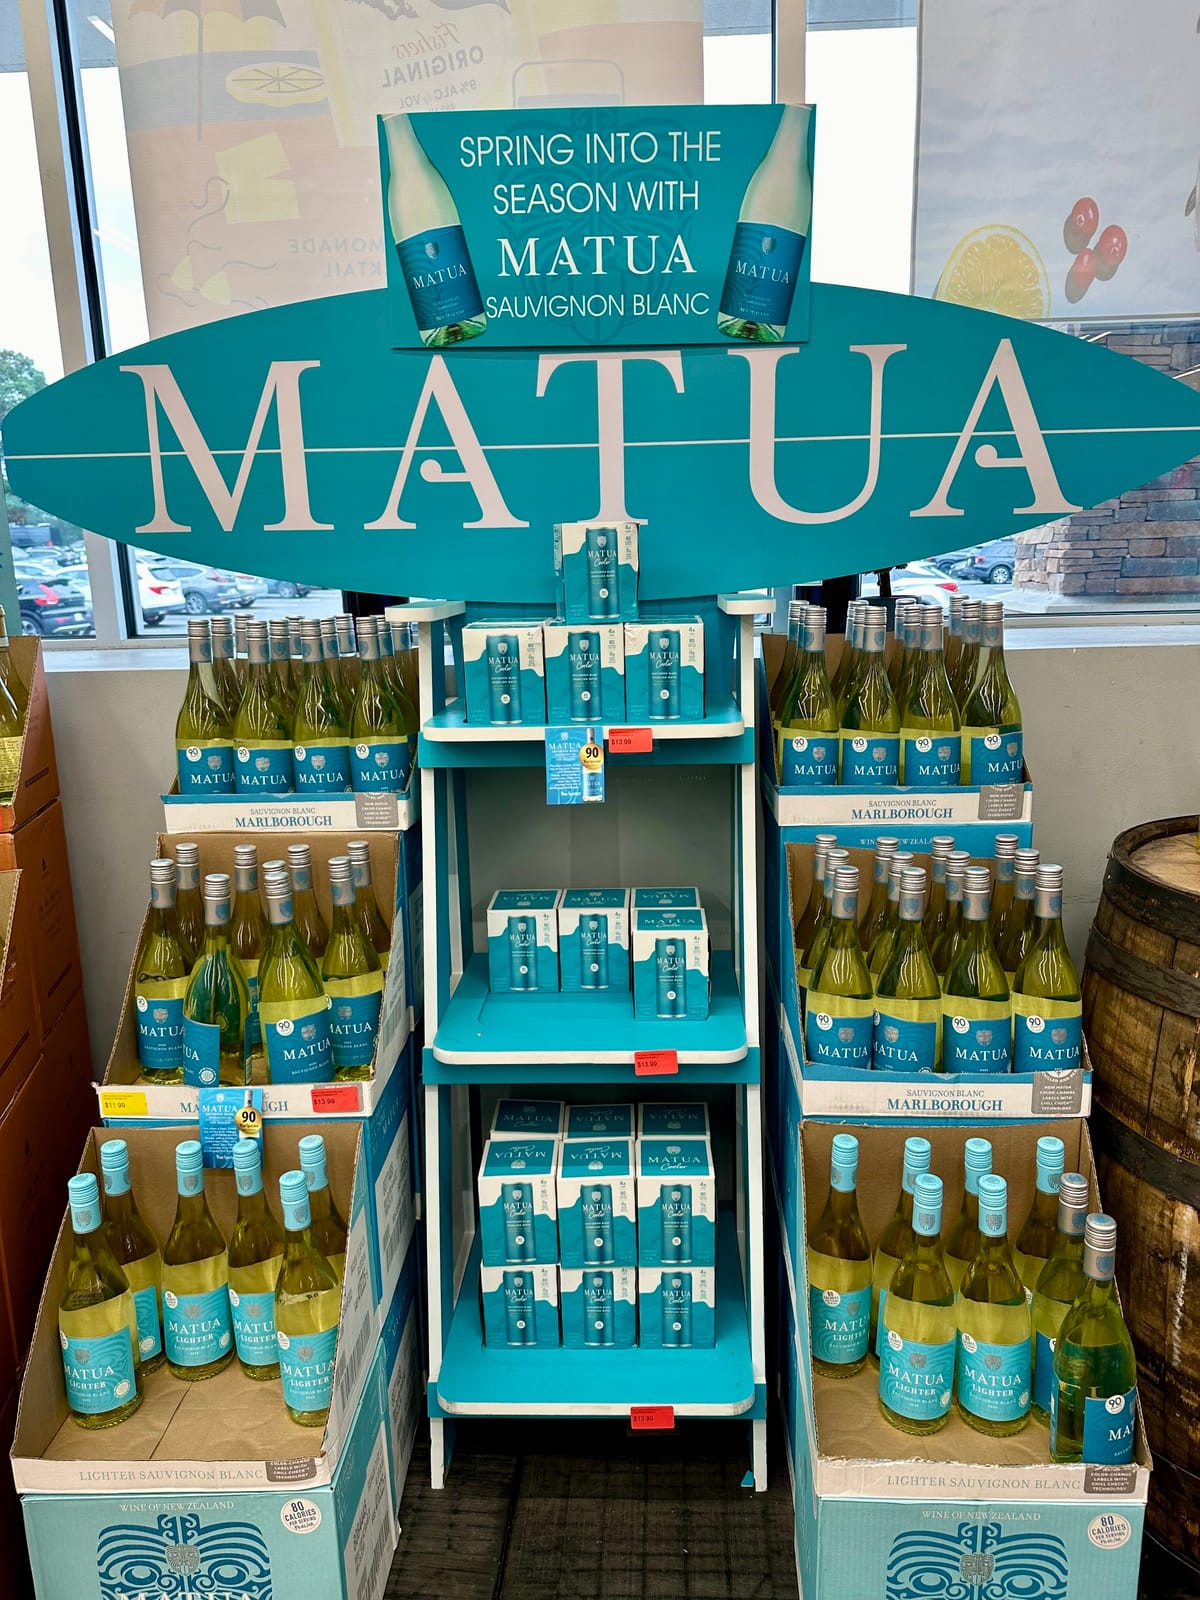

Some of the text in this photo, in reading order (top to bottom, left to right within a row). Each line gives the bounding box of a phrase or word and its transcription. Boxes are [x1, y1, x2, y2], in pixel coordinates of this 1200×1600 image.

[460, 130, 721, 168] SPRING INTO THE
[493, 180, 699, 215] SEASON WITH
[497, 234, 698, 277] MATUA
[412, 263, 467, 289] MATUA
[735, 260, 790, 283] MATUA
[486, 294, 624, 318] SAUVIGNON
[633, 292, 710, 315] BLANC
[119, 338, 1083, 534] MATUA
[587, 549, 617, 558] MATUA
[488, 656, 519, 665] MATUA
[569, 653, 600, 662] MATUA
[649, 651, 680, 661] MATUA
[794, 738, 805, 746] 90
[853, 738, 865, 746] 90
[918, 738, 929, 747] 90
[986, 735, 998, 744] 90
[357, 745, 366, 753] 90
[585, 747, 599, 758] 90
[794, 764, 836, 775] MATUA
[854, 764, 897, 776] MATUA
[988, 758, 1022, 773] MATU
[191, 772, 235, 784] MATUA
[241, 774, 287, 785] MATUA
[299, 772, 344, 784] MATUA
[360, 769, 405, 781] MATUA
[868, 799, 937, 808] SAUVIGNON BLANC
[292, 807, 315, 815] BLANC
[851, 808, 953, 820] MARLBOROUGH
[235, 815, 332, 828] MARLBOROUGH
[860, 838, 875, 846] WIN
[818, 1014, 829, 1023] 90
[954, 1018, 966, 1027] 90
[1028, 1017, 1041, 1026] 90
[278, 1021, 290, 1030] 90
[283, 1037, 331, 1061] MATUA
[818, 1043, 868, 1059] MATUA
[955, 1046, 1008, 1061] MATUA
[1029, 1045, 1080, 1060] MATUA
[906, 1089, 955, 1097] SAUVIGNON
[202, 1104, 237, 1113] MATUA
[887, 1098, 1003, 1111] MARLBOROUGH
[242, 1111, 256, 1123] 90
[503, 1202, 533, 1210] MATUA
[582, 1203, 612, 1211] MATUA
[662, 1202, 691, 1211] MATUA
[169, 1317, 221, 1334] MATUA
[175, 1333, 214, 1344] LIGHTER
[283, 1359, 335, 1378] MATUA
[888, 1362, 944, 1386] MATUA
[290, 1375, 330, 1387] LIGHTER
[964, 1365, 1022, 1387] MATUA
[69, 1379, 107, 1390] LIGHTER
[895, 1381, 936, 1396] LIGHTER
[972, 1383, 1014, 1398] LIGHTER
[1107, 1397, 1122, 1408] 90
[80, 1469, 263, 1481] LIGHTER SAUVIGNON BLANC
[887, 1475, 1081, 1490] LIGHTER SAUVIGNON BLANC
[119, 1501, 234, 1512] WINE OF NEW ZEALAND
[290, 1501, 304, 1513] 80
[284, 1508, 317, 1522] CALORIES
[922, 1511, 1041, 1521] WINE OF NEW ZEALAND
[1100, 1515, 1114, 1527] 80
[1091, 1524, 1127, 1536] CALORIES
